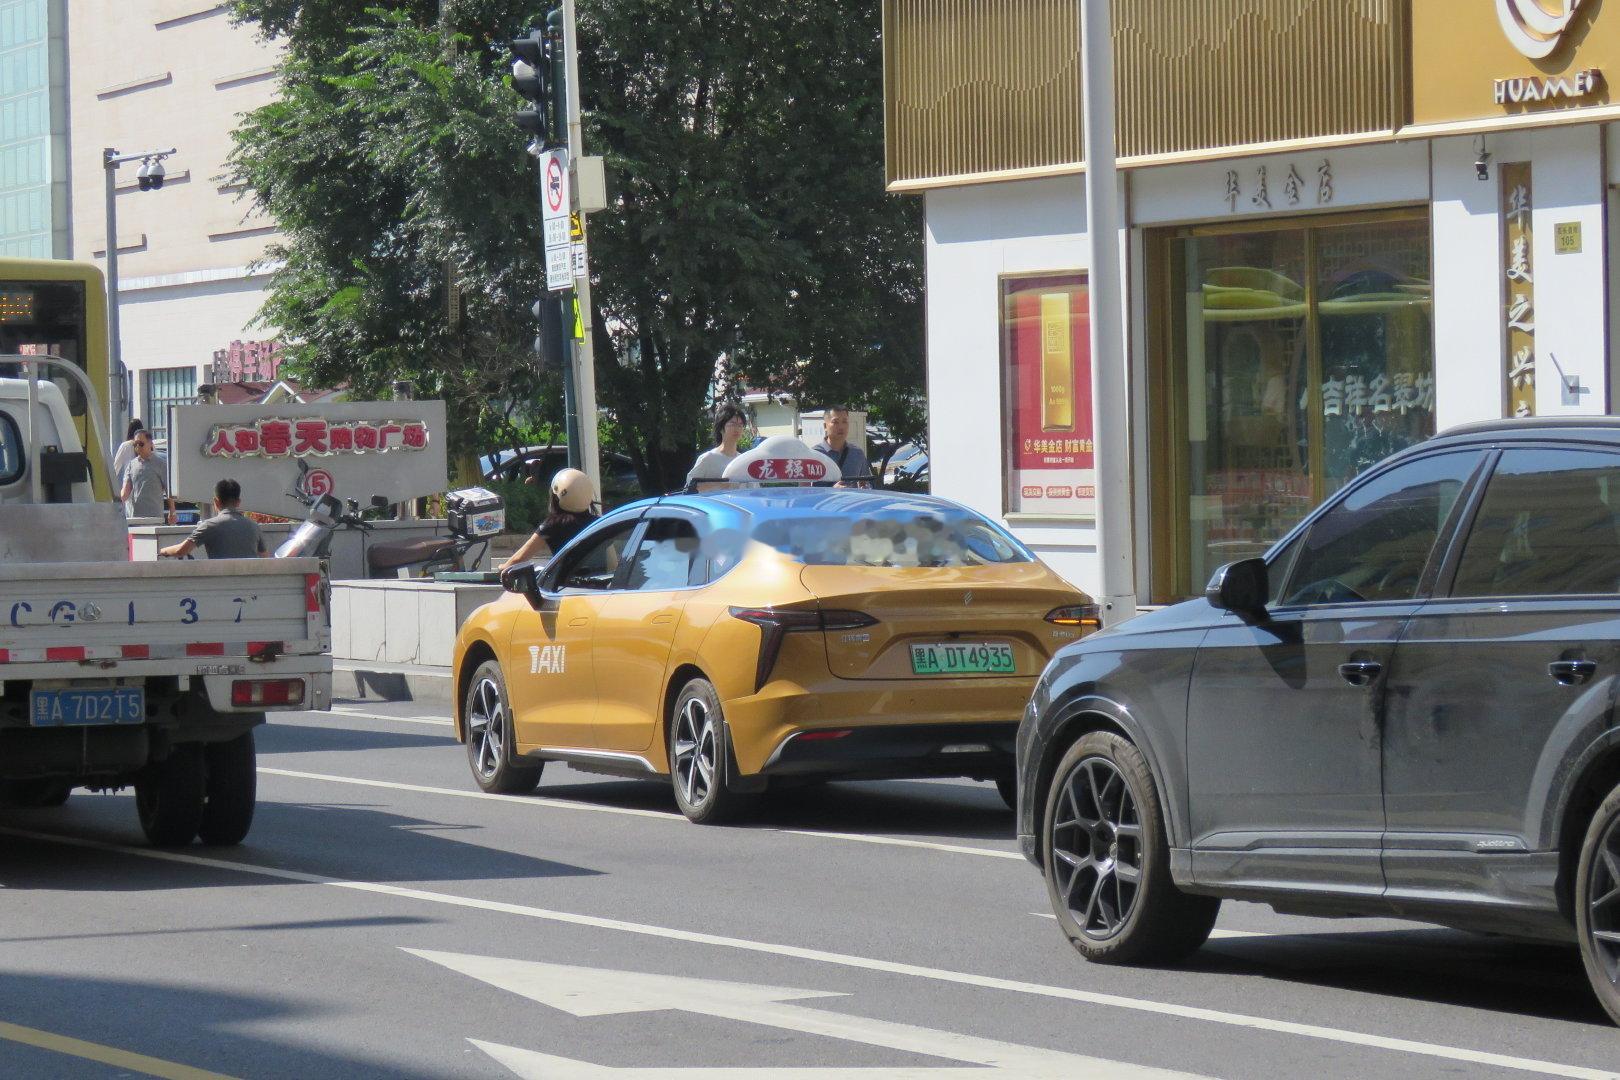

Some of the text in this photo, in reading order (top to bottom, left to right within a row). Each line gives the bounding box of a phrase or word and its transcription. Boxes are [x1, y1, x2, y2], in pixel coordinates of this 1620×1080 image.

[1493, 71, 1594, 104] HUAMEI
[1560, 235, 1575, 246] 105
[210, 420, 427, 455] 人和春天购物广场
[1033, 439, 1063, 454] 华美金店
[759, 459, 823, 479] 龙强 TAXI
[528, 645, 566, 674] TAXI
[946, 646, 1013, 669] DT4935
